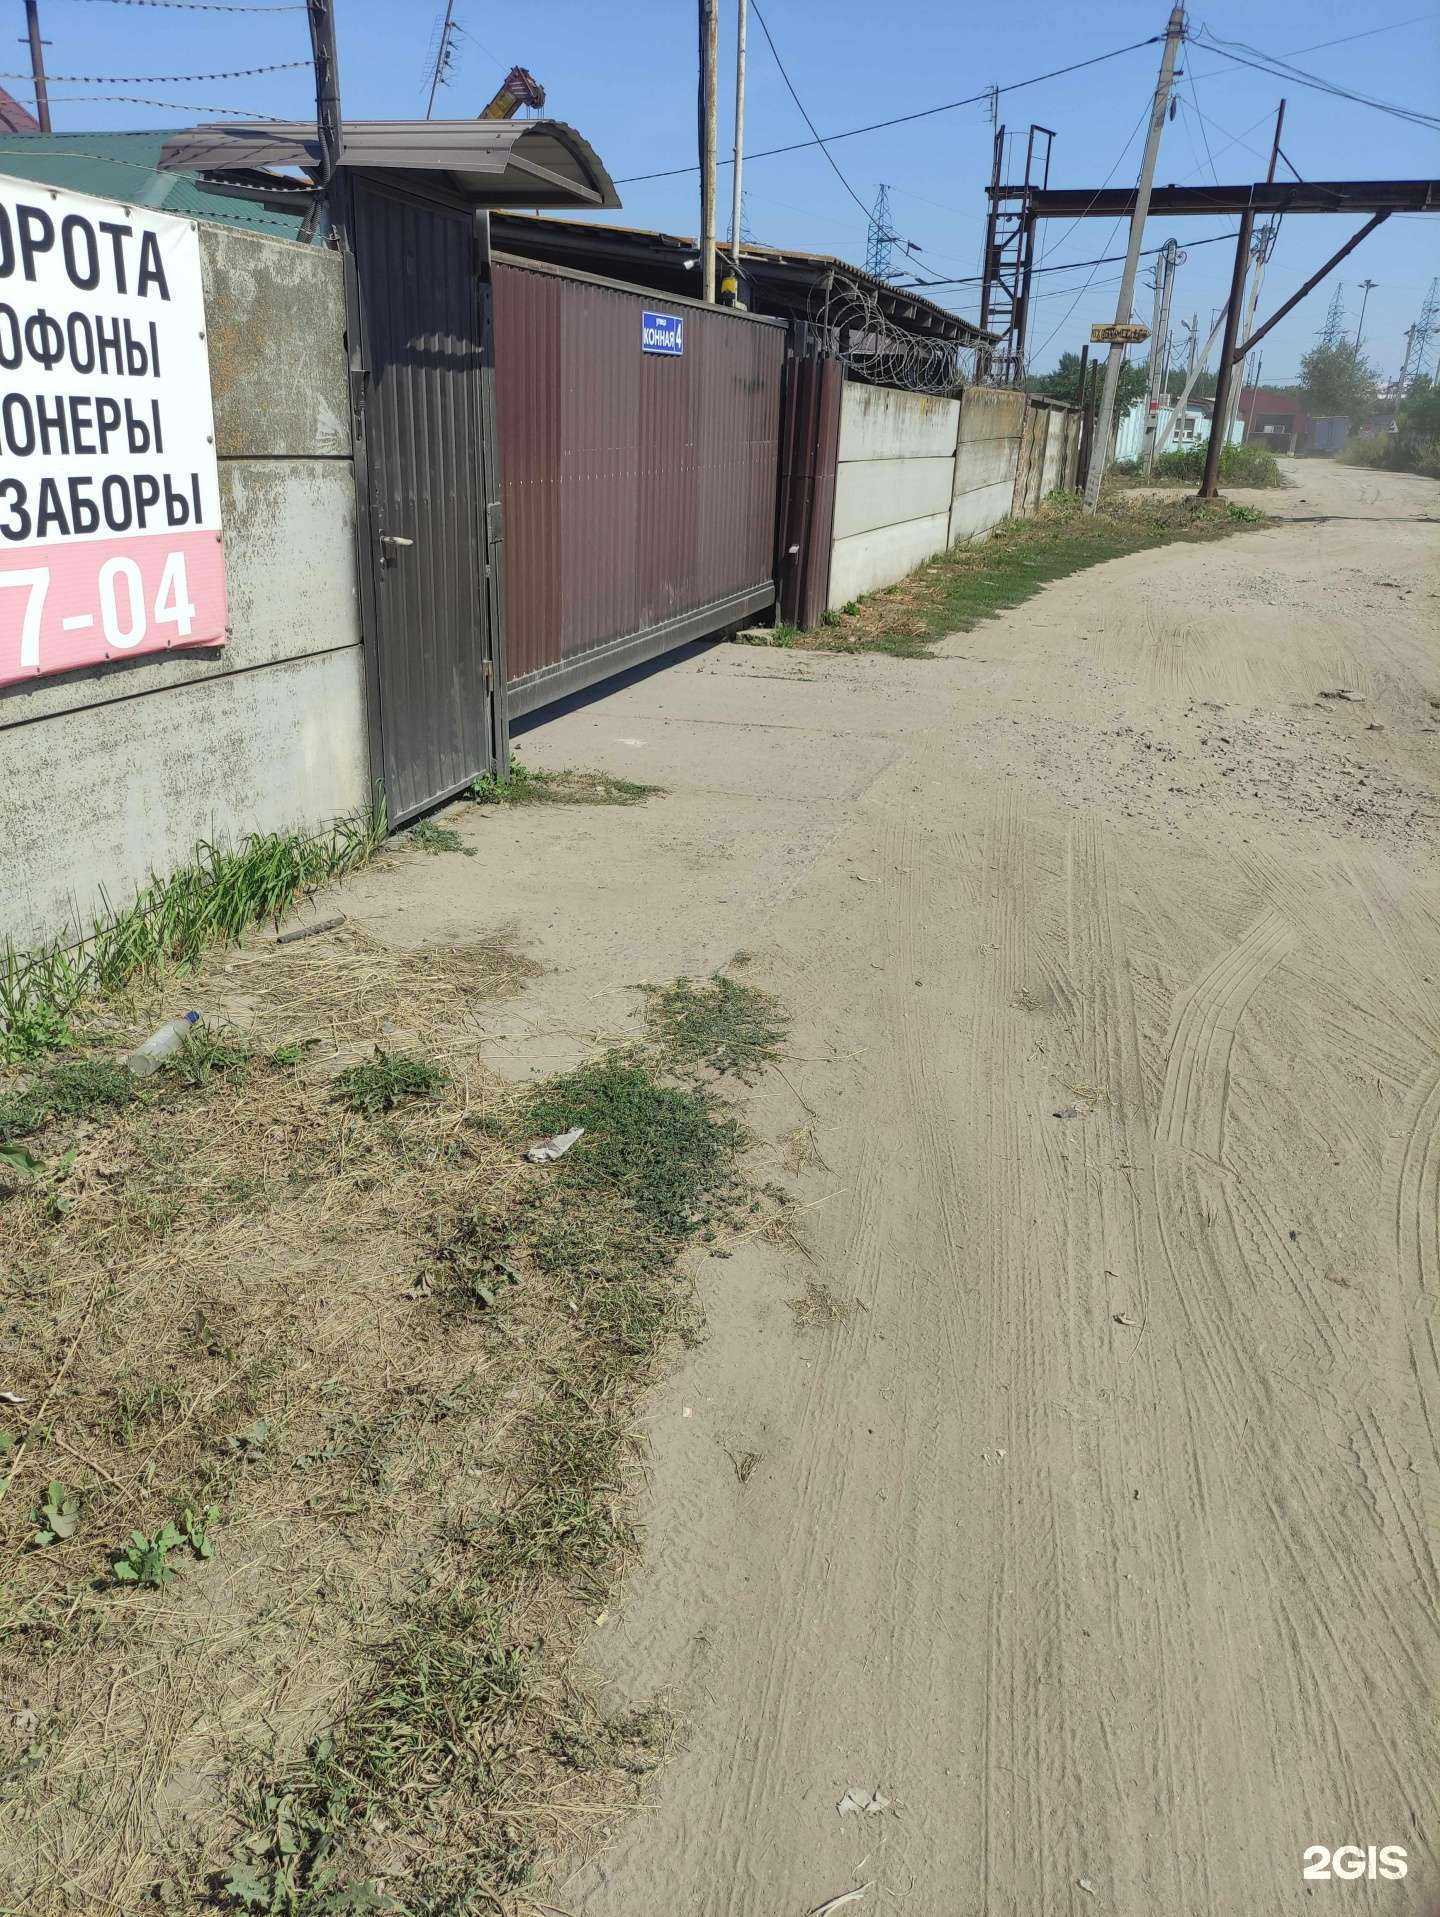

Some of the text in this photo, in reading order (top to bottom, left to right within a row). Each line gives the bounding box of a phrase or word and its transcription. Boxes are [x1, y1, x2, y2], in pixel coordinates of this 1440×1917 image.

[643, 323, 682, 349] КОННАЯ 4
[0, 393, 164, 457] ОНЕРЫ
[0, 472, 202, 541] ЗАБОРЫ
[0, 551, 196, 667] 7-04
